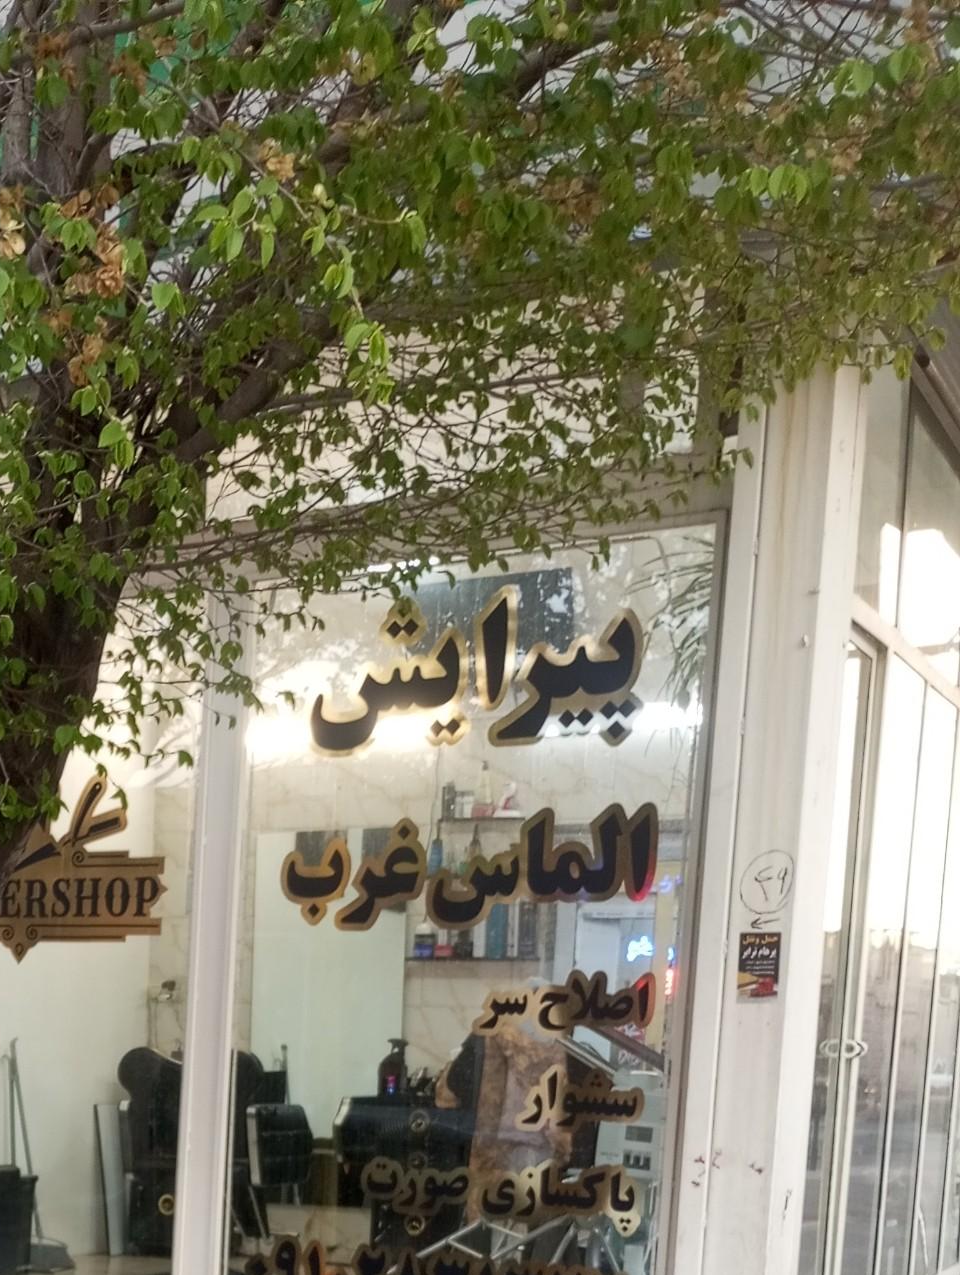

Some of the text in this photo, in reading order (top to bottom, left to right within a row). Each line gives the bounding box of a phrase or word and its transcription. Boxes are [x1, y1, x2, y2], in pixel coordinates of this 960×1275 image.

[311, 587, 641, 753] پیرایش
[283, 804, 657, 930] الماس غرب
[476, 992, 530, 1033] سر
[536, 972, 653, 1034] اصلاح
[518, 1067, 642, 1130] سشوار
[363, 1159, 471, 1212] صورت
